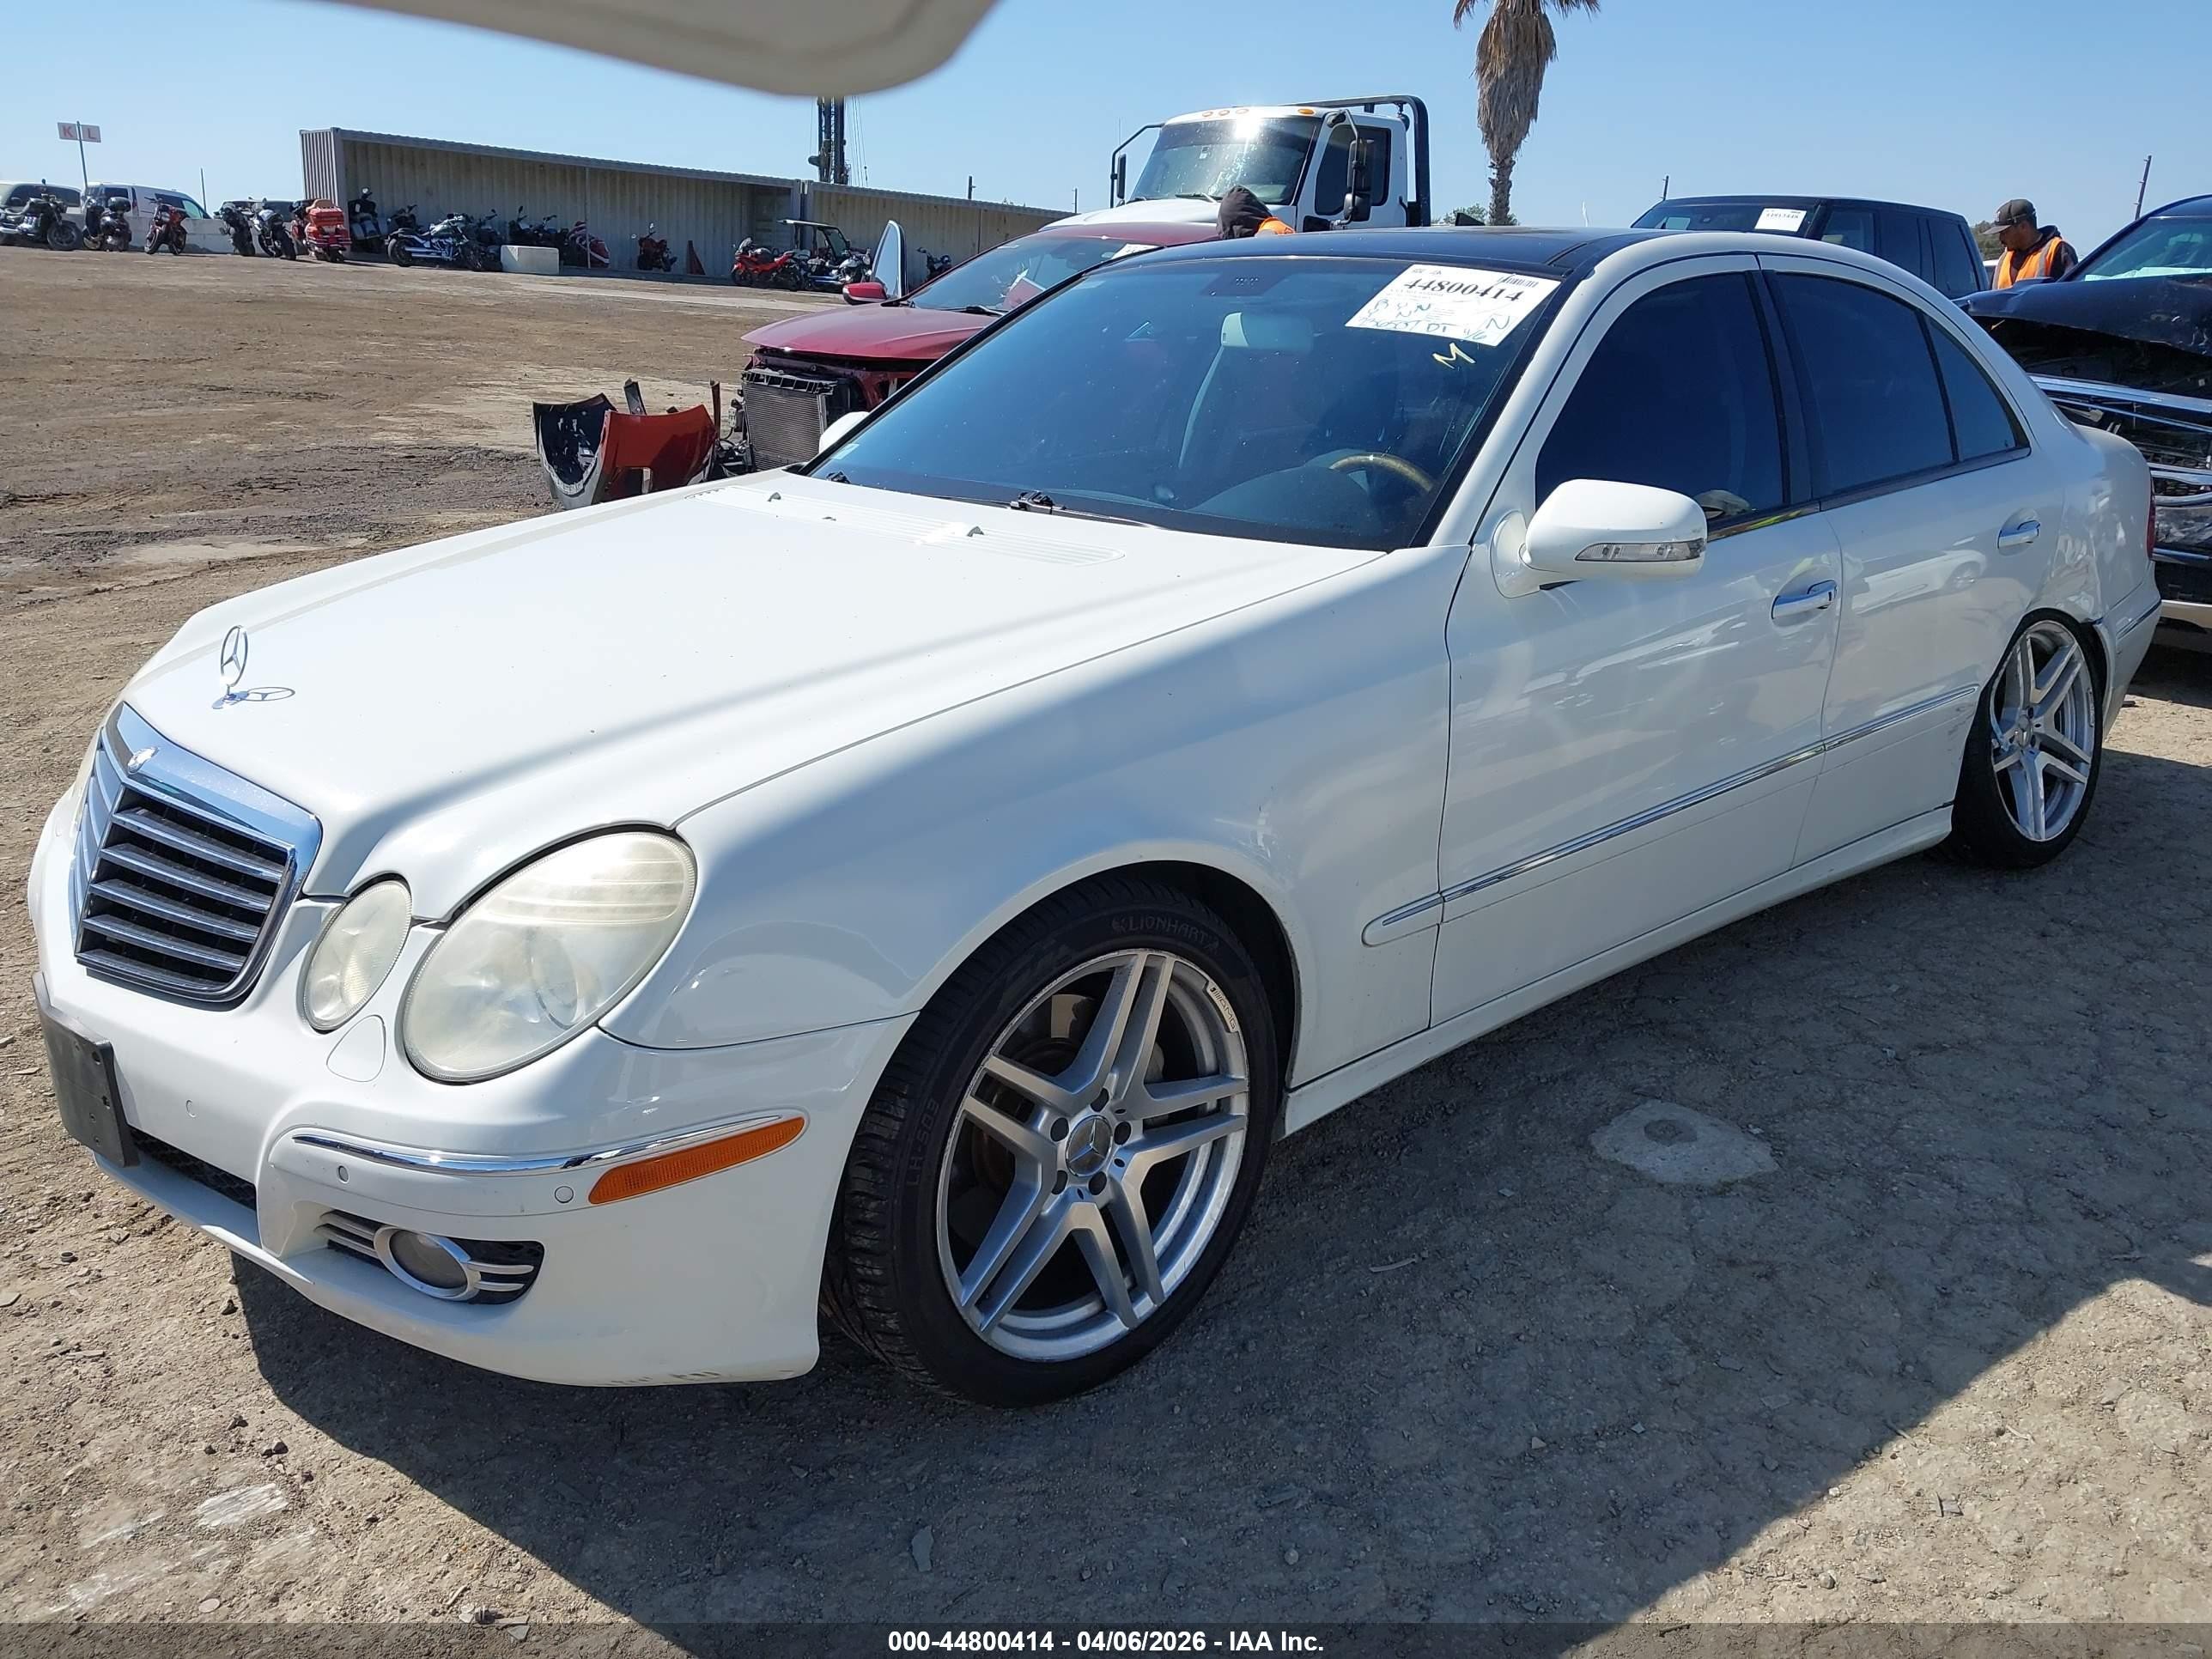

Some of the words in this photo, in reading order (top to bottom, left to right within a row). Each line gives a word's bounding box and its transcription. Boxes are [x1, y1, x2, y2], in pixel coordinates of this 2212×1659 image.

[62, 125, 74, 137] K
[88, 128, 97, 140] L
[1404, 278, 1524, 301] 44800414
[1486, 315, 1510, 330] N
[1432, 343, 1476, 368] M
[1128, 915, 1209, 944] LIONHART
[1218, 998, 1237, 1030] AMG
[906, 1097, 940, 1186] LH-503
